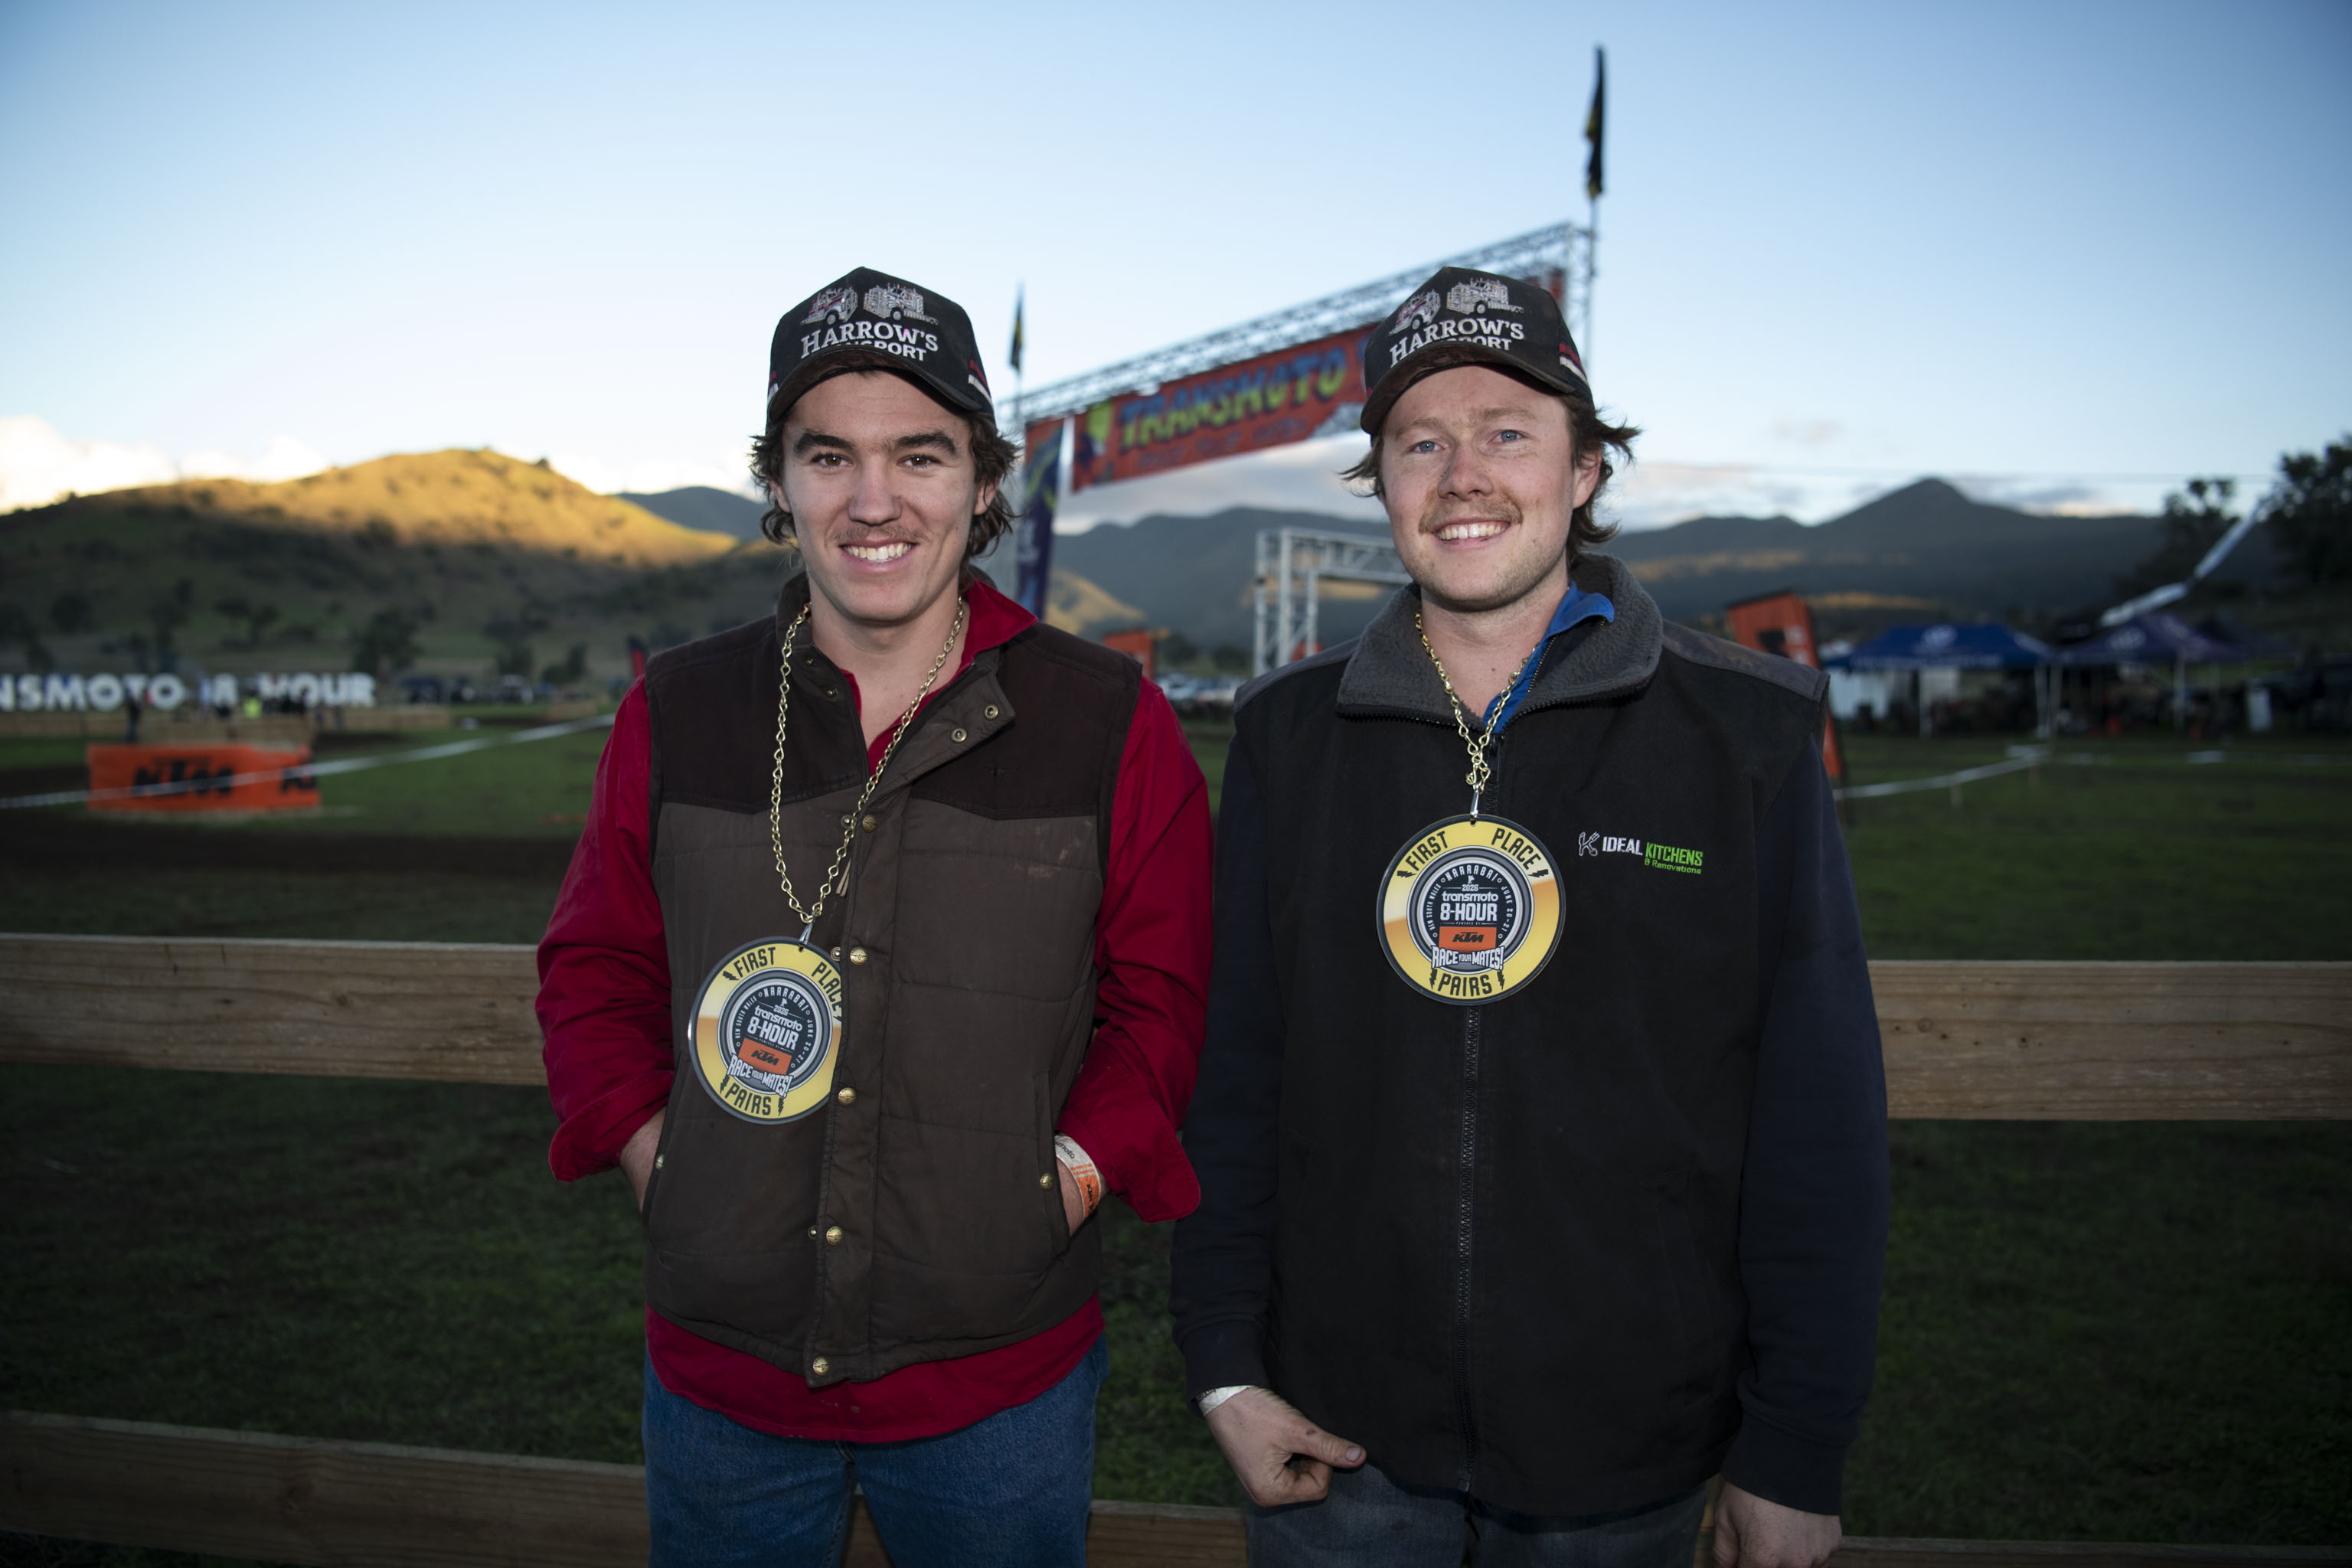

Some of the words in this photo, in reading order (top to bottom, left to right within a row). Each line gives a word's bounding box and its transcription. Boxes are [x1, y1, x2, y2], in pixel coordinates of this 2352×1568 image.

[800, 320, 939, 360] HARROW'S
[1388, 317, 1526, 369] HARROW'S
[1405, 831, 1449, 871] FIRST
[1491, 828, 1542, 871] PLACE
[1602, 836, 1643, 856] IDEAL
[1645, 842, 1704, 867] KITCHENS
[1442, 890, 1499, 902] transmoto
[1439, 902, 1498, 922] 8-HOUR
[1452, 931, 1484, 943] KTM
[733, 946, 776, 978] FIRST
[1432, 946, 1459, 969] RACE
[1459, 953, 1472, 962] YOUR
[1472, 946, 1504, 971] MATES!
[1438, 972, 1492, 997] PAIRS
[746, 1016, 799, 1050] 8-HOUR
[754, 1005, 803, 1032] transmoto
[750, 1049, 779, 1066] KTM
[727, 1054, 754, 1079] RACE
[761, 1071, 794, 1098] MATES!
[724, 1083, 772, 1116] PAIRS
